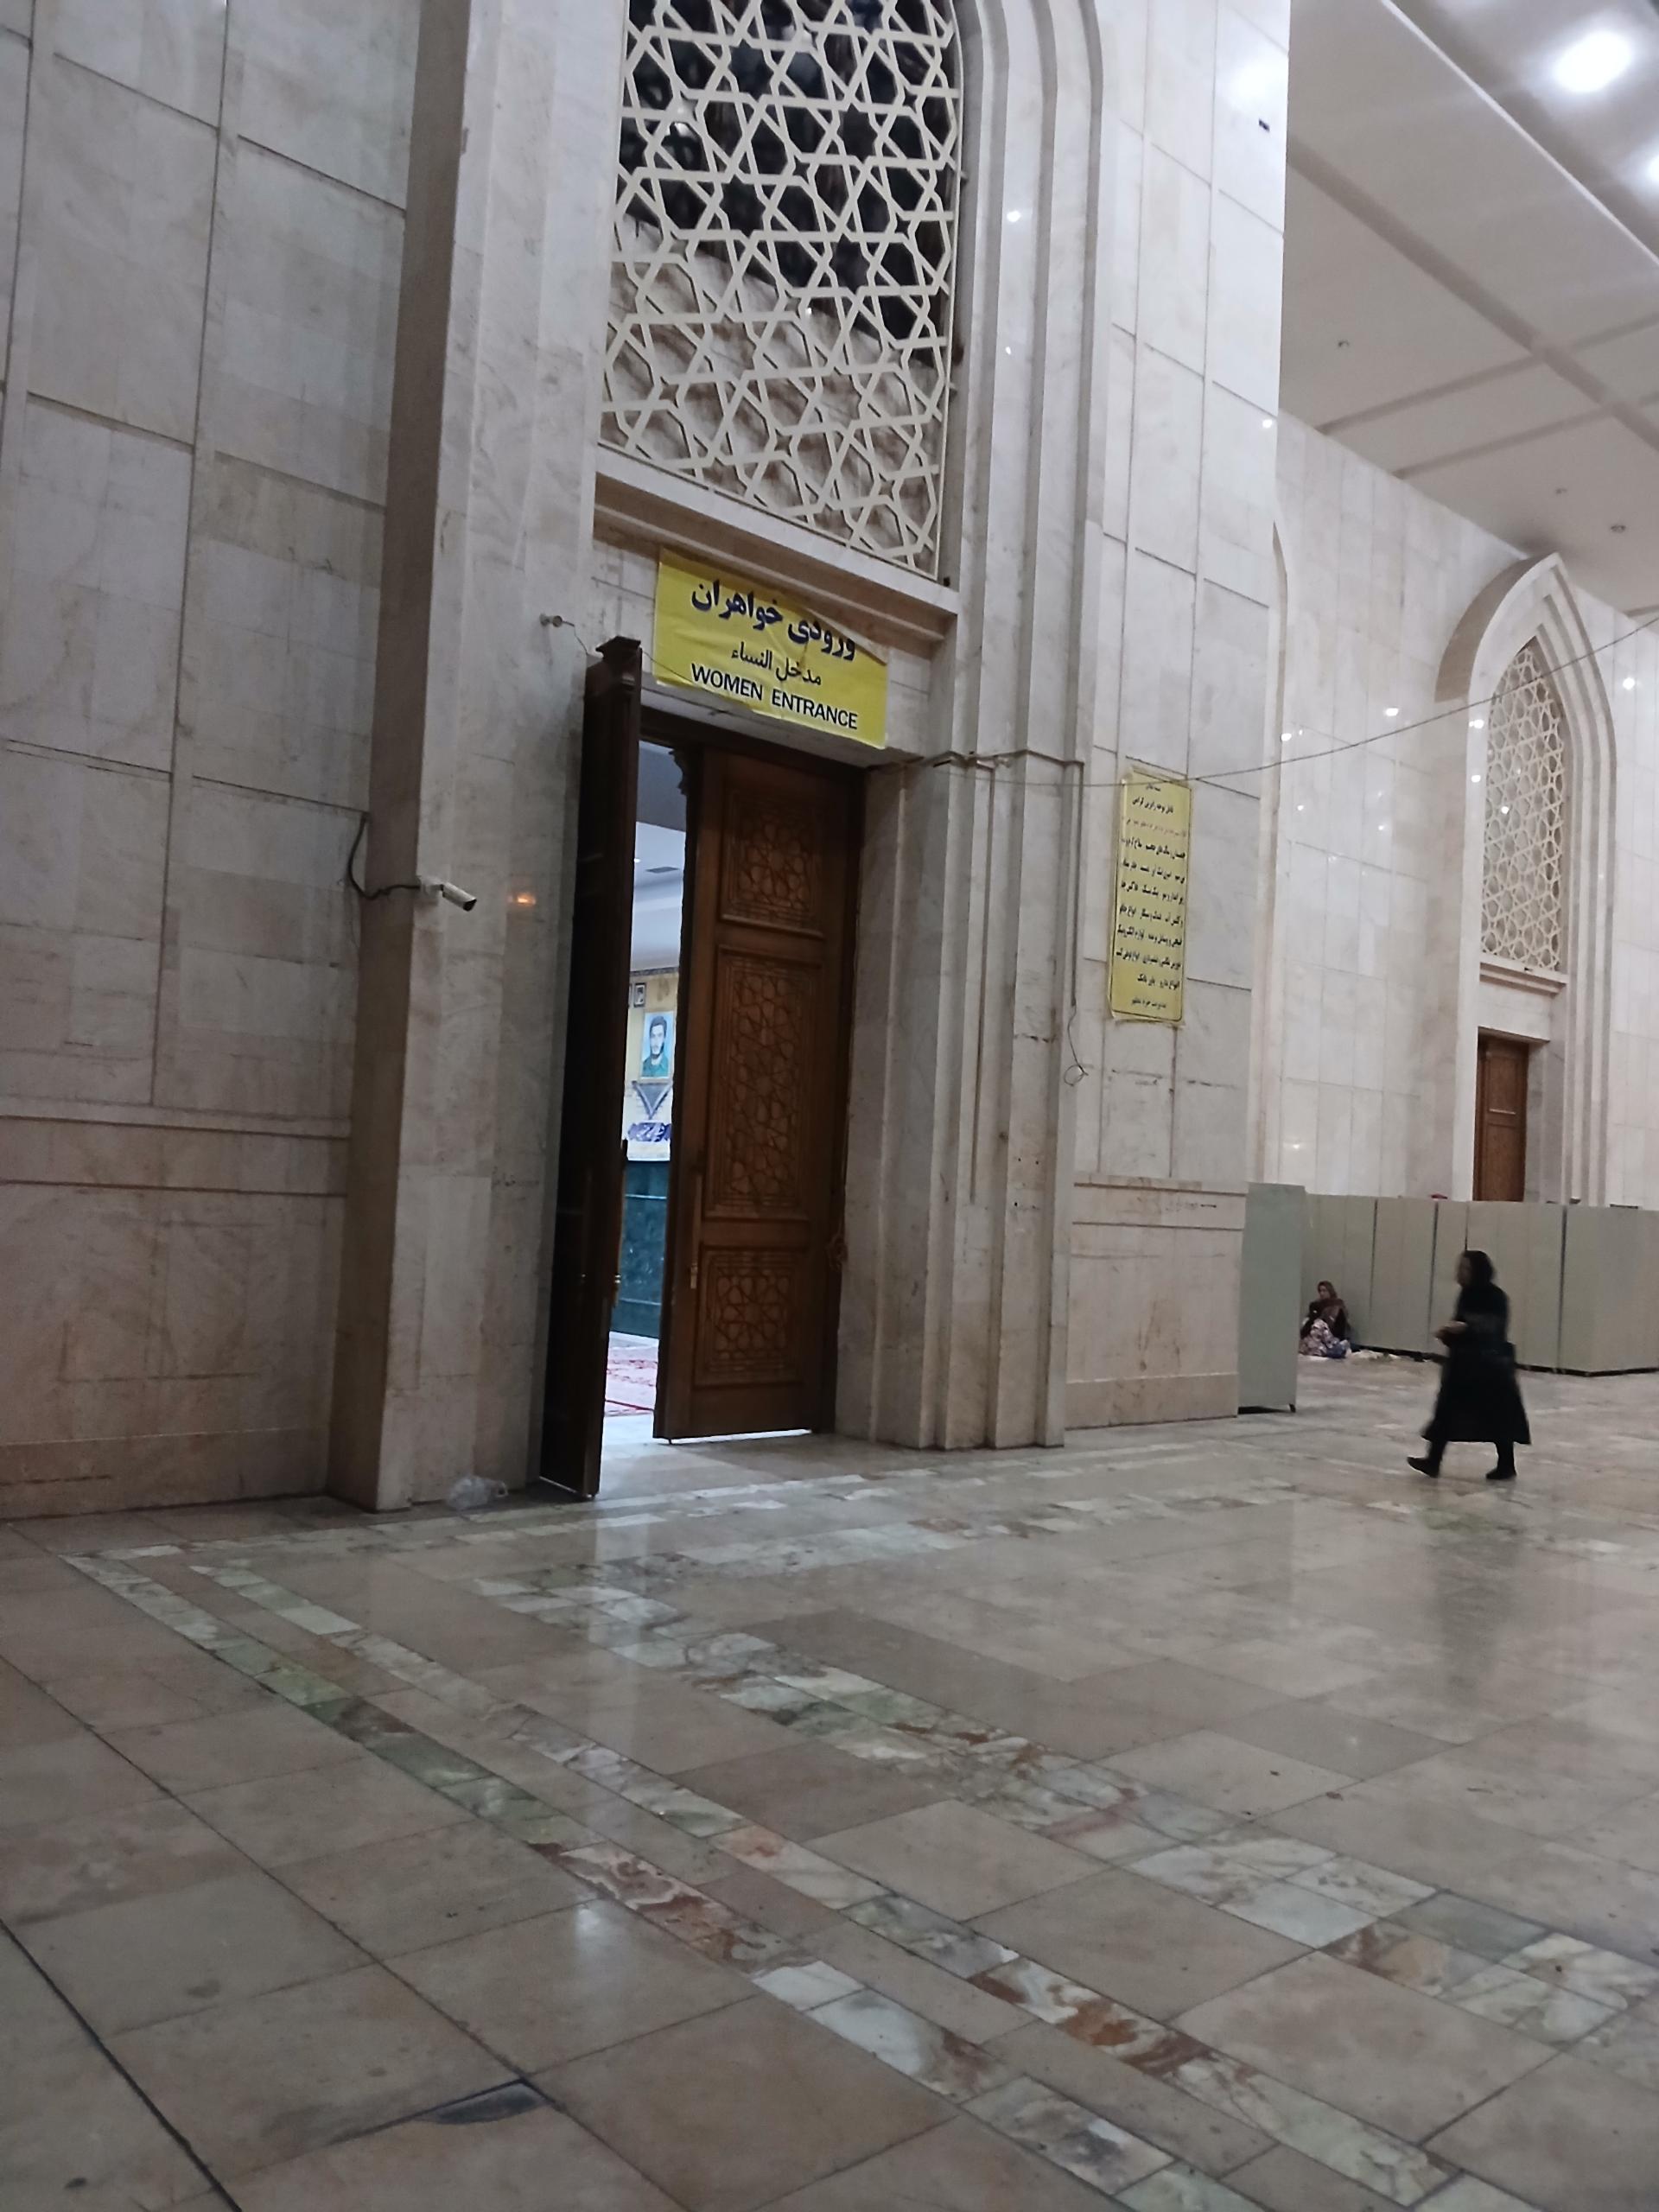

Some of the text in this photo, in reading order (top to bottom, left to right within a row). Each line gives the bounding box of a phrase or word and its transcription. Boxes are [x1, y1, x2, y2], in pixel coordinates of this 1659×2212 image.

[691, 580, 855, 661] ورودی خواهران
[731, 641, 822, 685] مدخل النساء
[691, 664, 858, 729] WOMEN ENTRANCE
